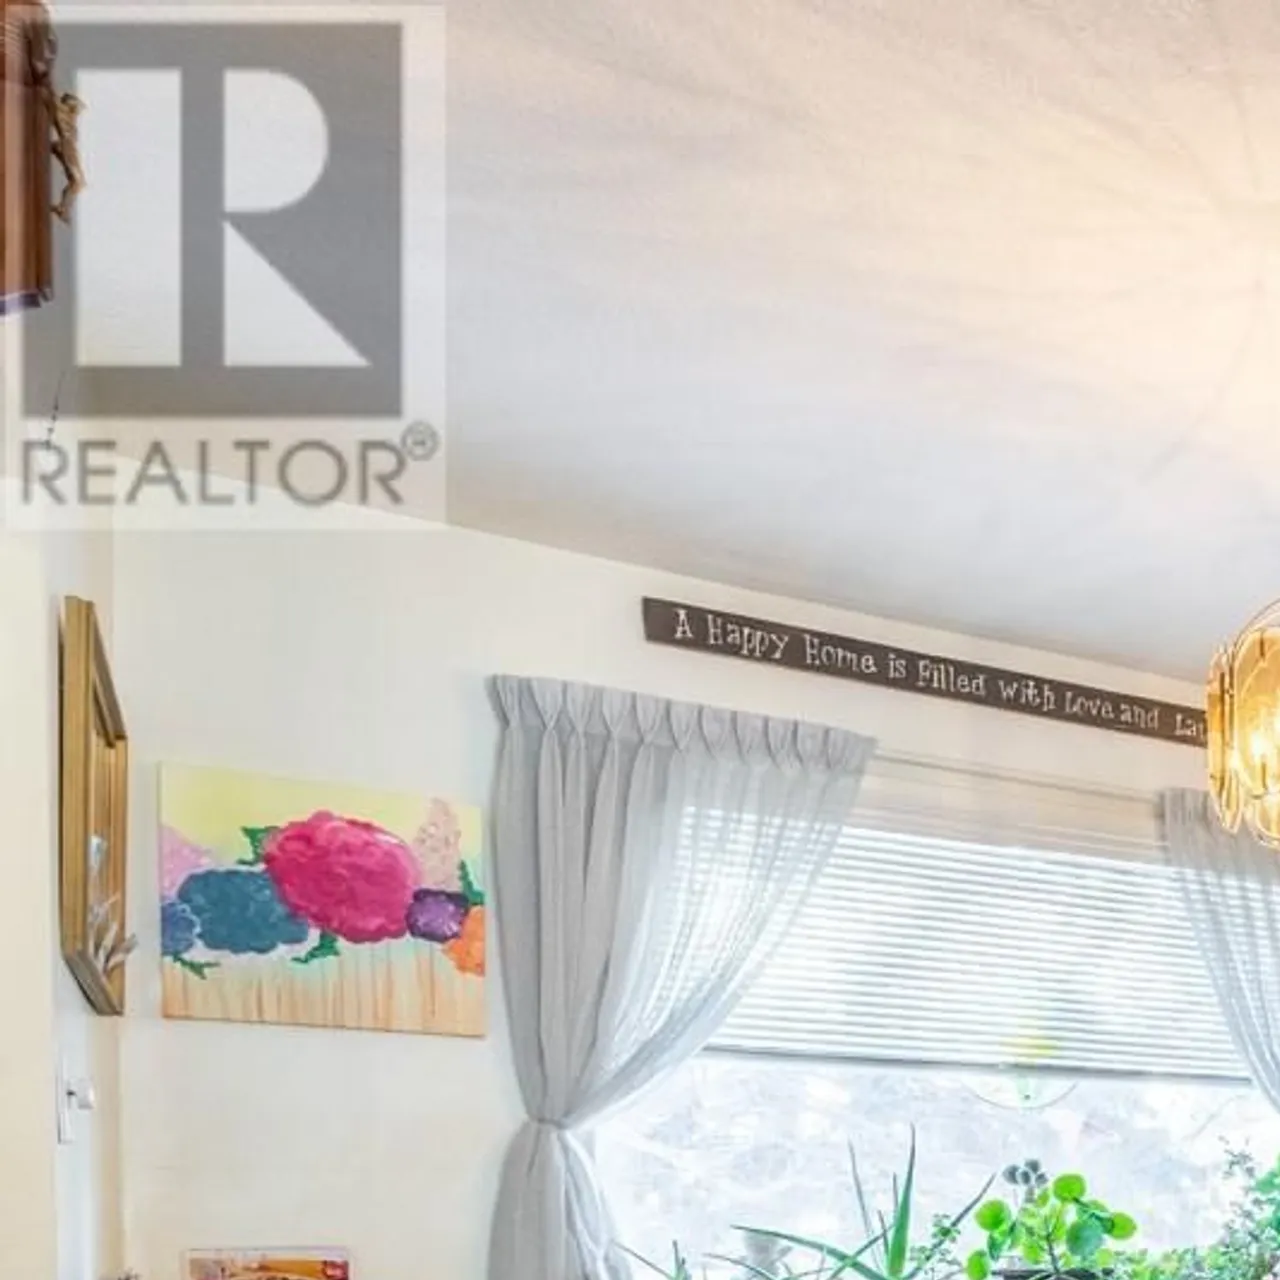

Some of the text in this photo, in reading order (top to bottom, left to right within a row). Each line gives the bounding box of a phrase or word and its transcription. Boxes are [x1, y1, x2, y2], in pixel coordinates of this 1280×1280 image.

[674, 608, 694, 640] A
[707, 613, 789, 660] Happy
[804, 633, 878, 674] Home
[887, 652, 907, 680] is
[918, 659, 987, 697] Filled
[1000, 679, 1056, 712] with
[1065, 690, 1115, 720] Love
[1120, 702, 1159, 730] and
